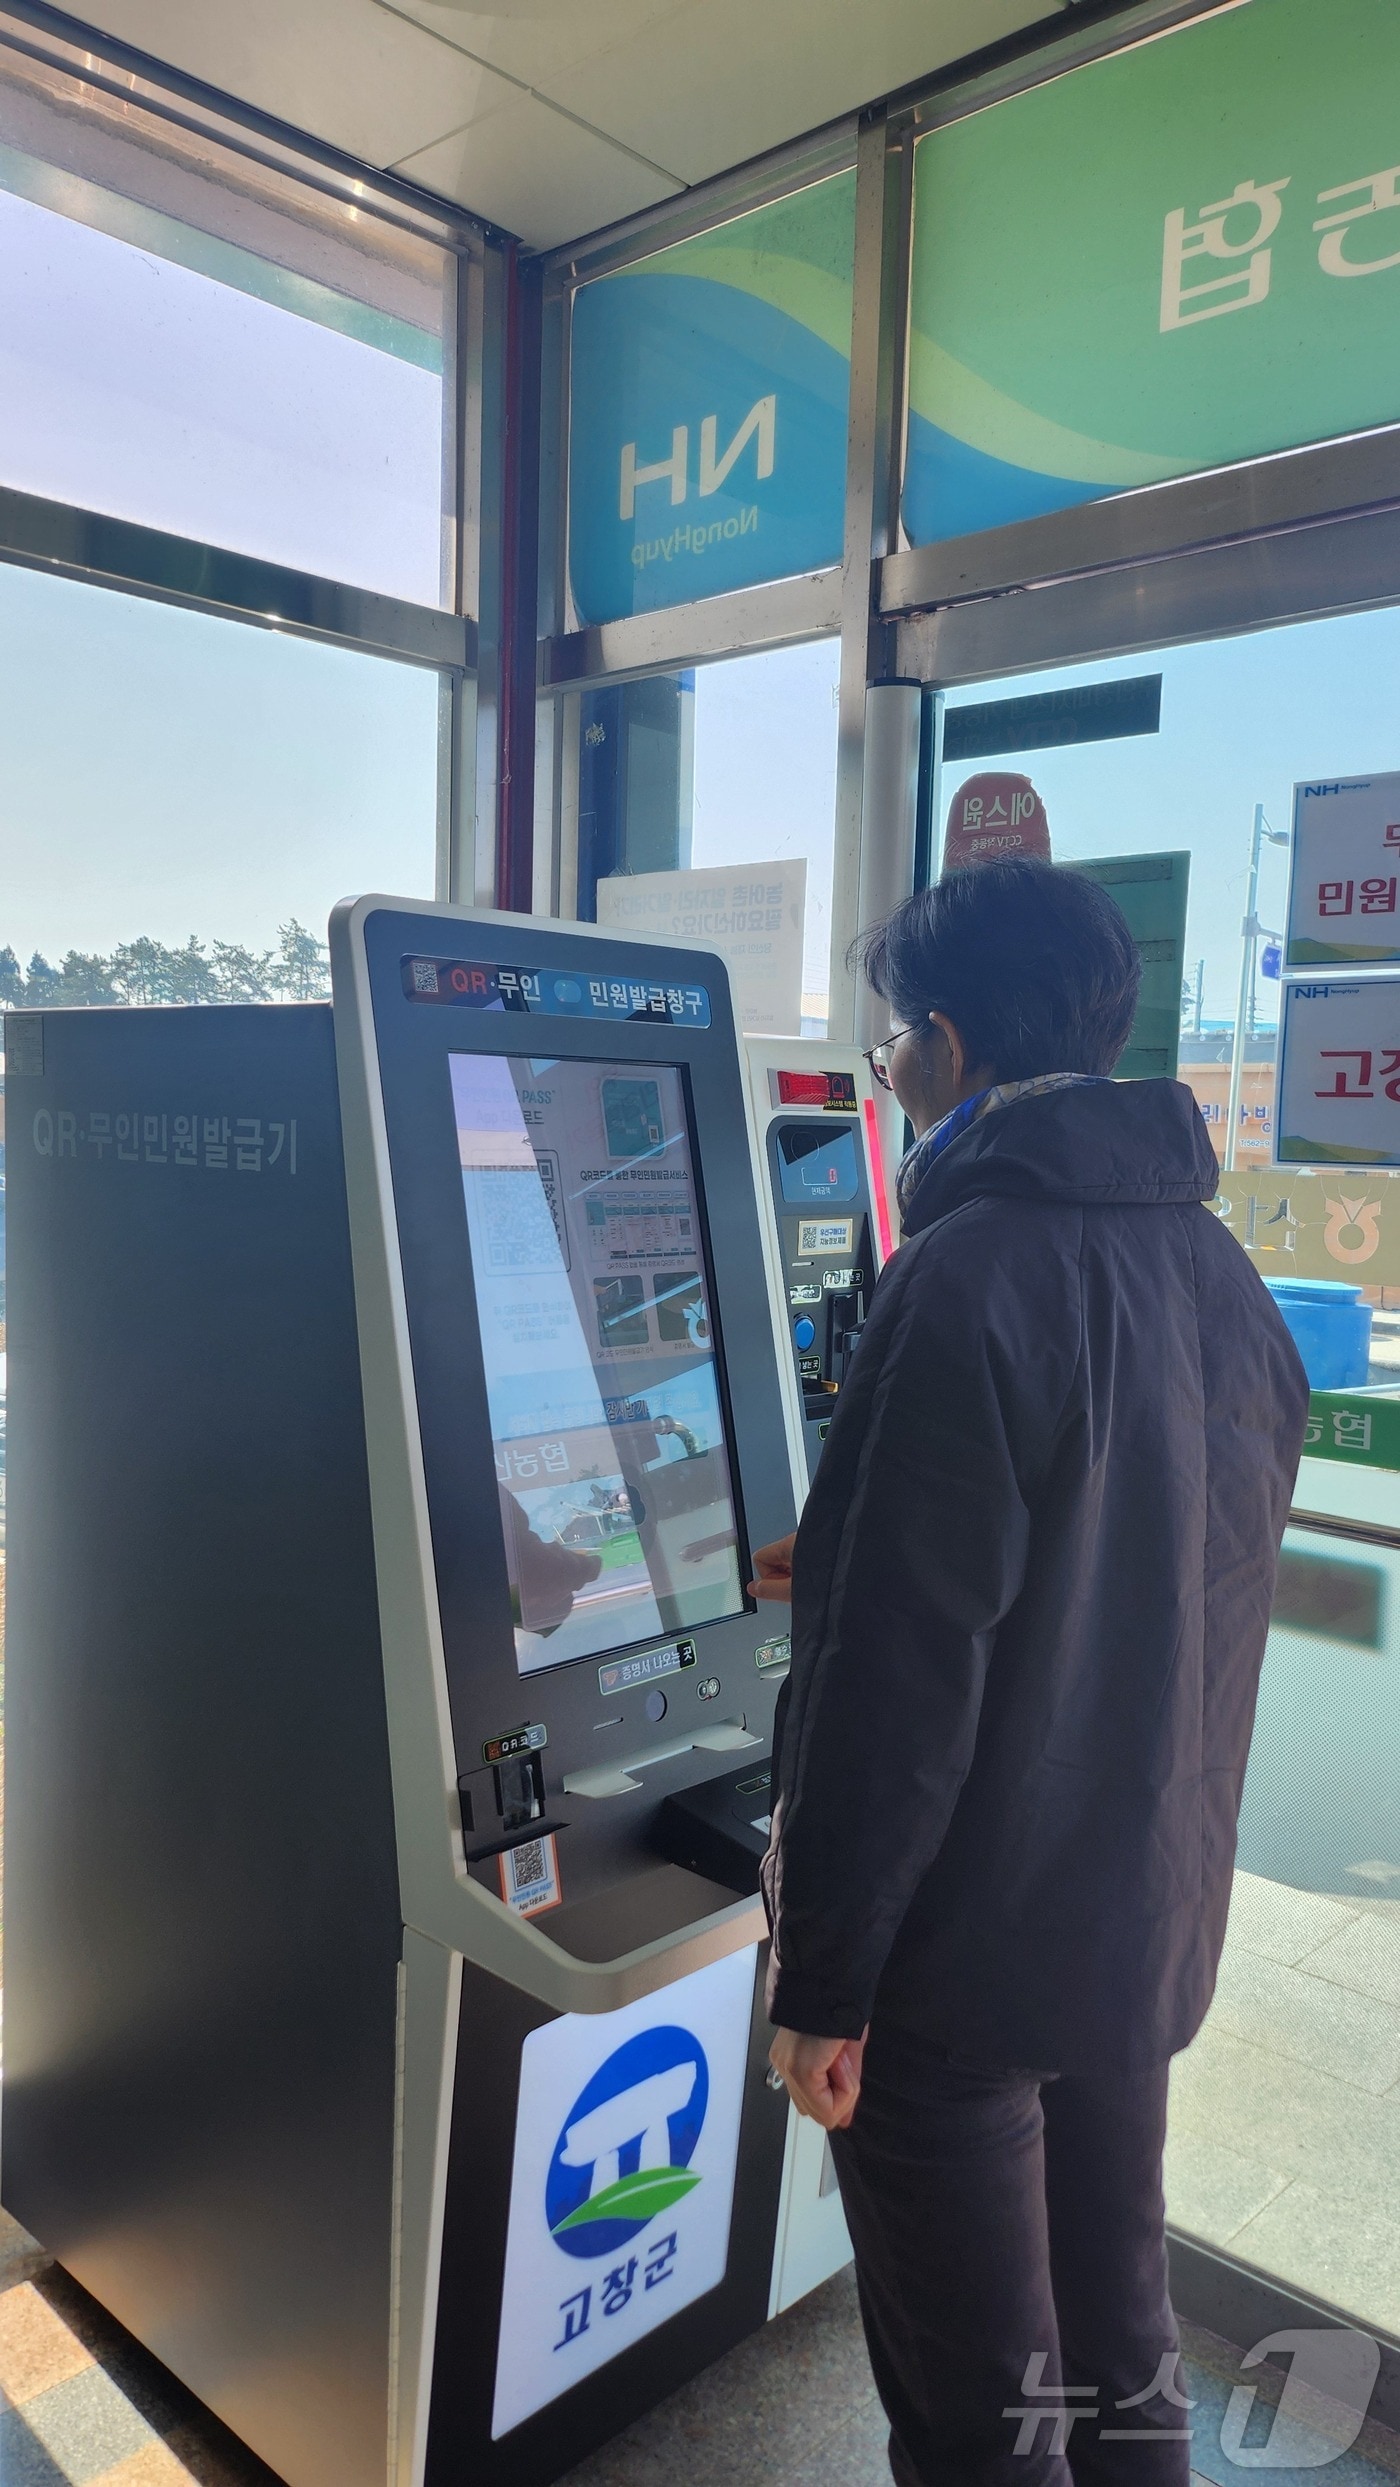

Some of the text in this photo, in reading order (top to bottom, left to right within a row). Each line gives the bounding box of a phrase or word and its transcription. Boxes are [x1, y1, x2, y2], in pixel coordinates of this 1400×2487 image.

[1304, 783, 1340, 798] NH
[1317, 876, 1397, 917] 민원
[588, 980, 703, 1016] 민원발급창구
[1294, 986, 1330, 999] NH
[653, 1651, 681, 1670] 나오는
[682, 1646, 693, 1662] 곳
[552, 2230, 678, 2353] 고창군
